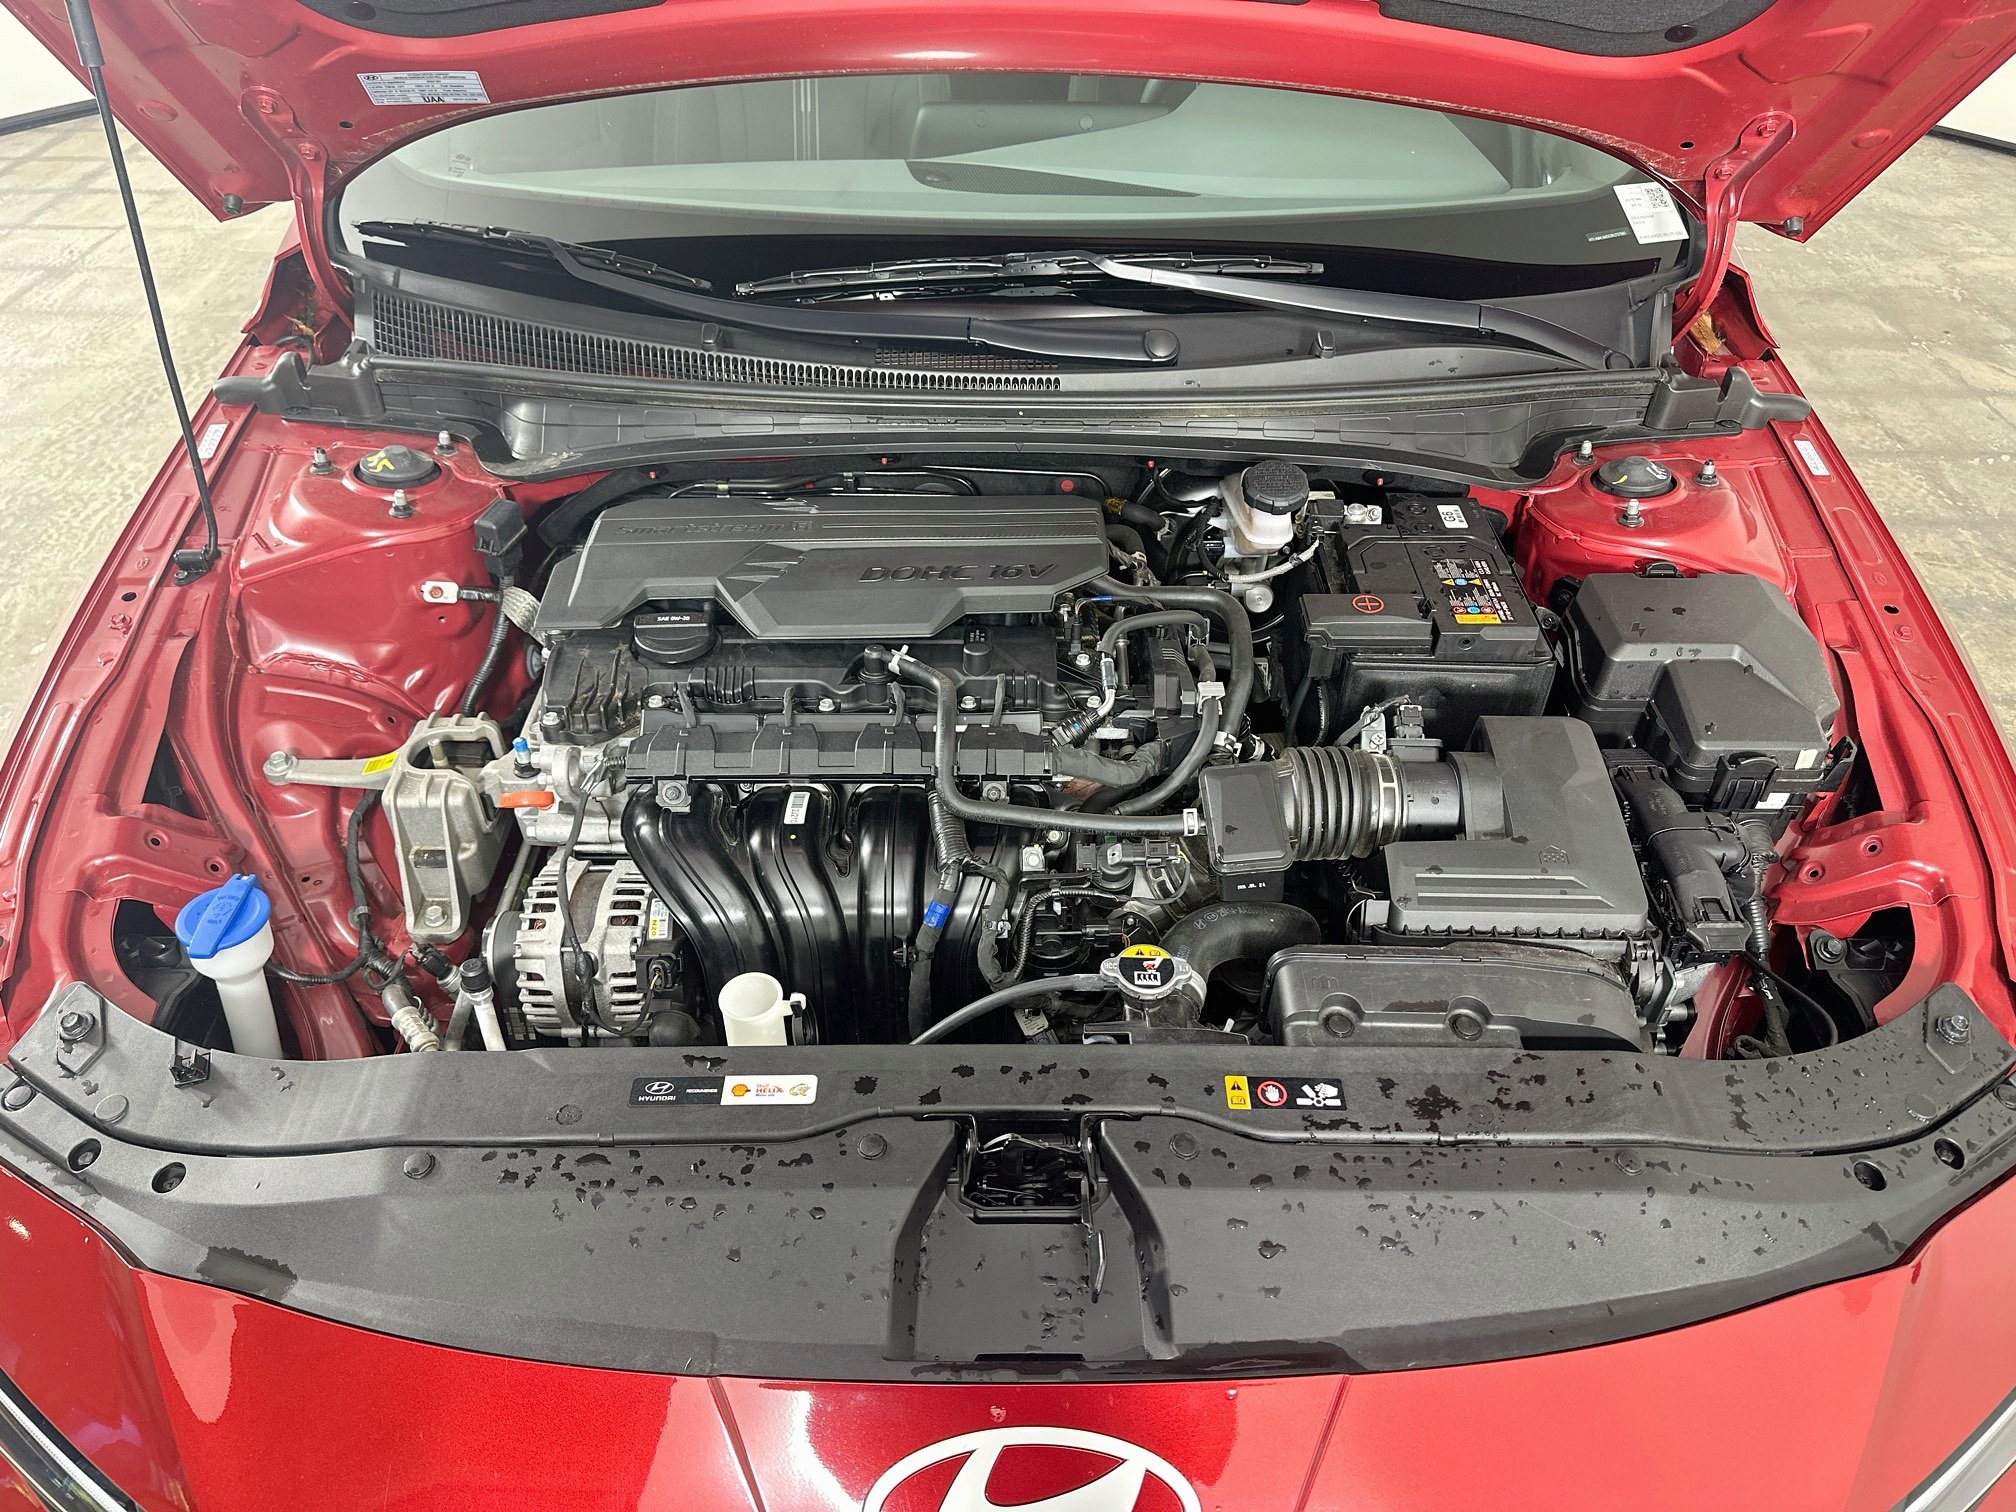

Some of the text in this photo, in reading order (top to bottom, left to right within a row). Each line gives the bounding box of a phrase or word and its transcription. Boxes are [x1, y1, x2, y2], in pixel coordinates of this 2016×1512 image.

[858, 563, 1057, 583] DOHC 16V
[1104, 962, 1118, 970] HCC
